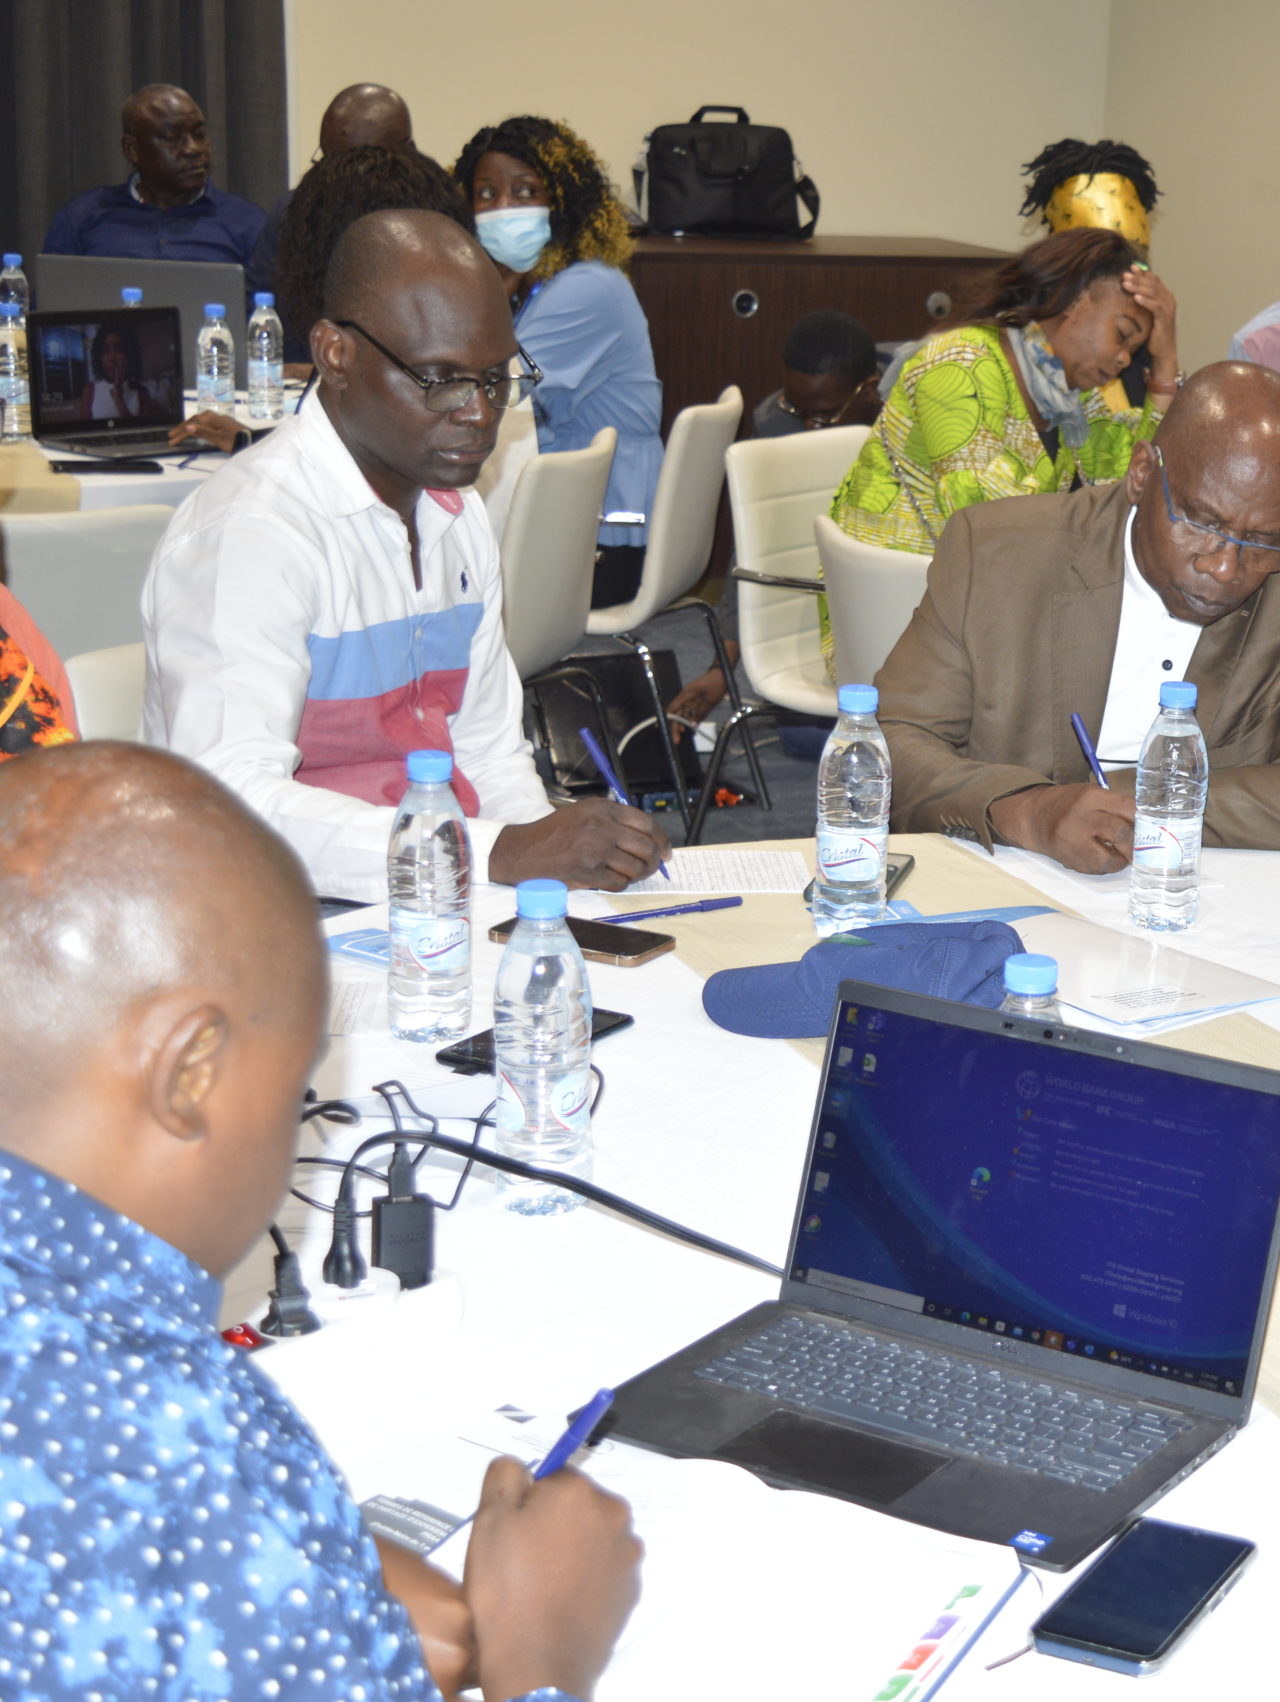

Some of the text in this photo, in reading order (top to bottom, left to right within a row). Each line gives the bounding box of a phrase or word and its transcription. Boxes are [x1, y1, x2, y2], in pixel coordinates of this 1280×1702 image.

[821, 843, 864, 863] Cristal
[417, 924, 465, 954] Cristal
[1045, 1076, 1144, 1104] WORLD BANK GROUP
[1096, 1105, 1111, 1115] IFC
[1128, 1308, 1177, 1328] Windows 10
[992, 1338, 1018, 1354] DELL
